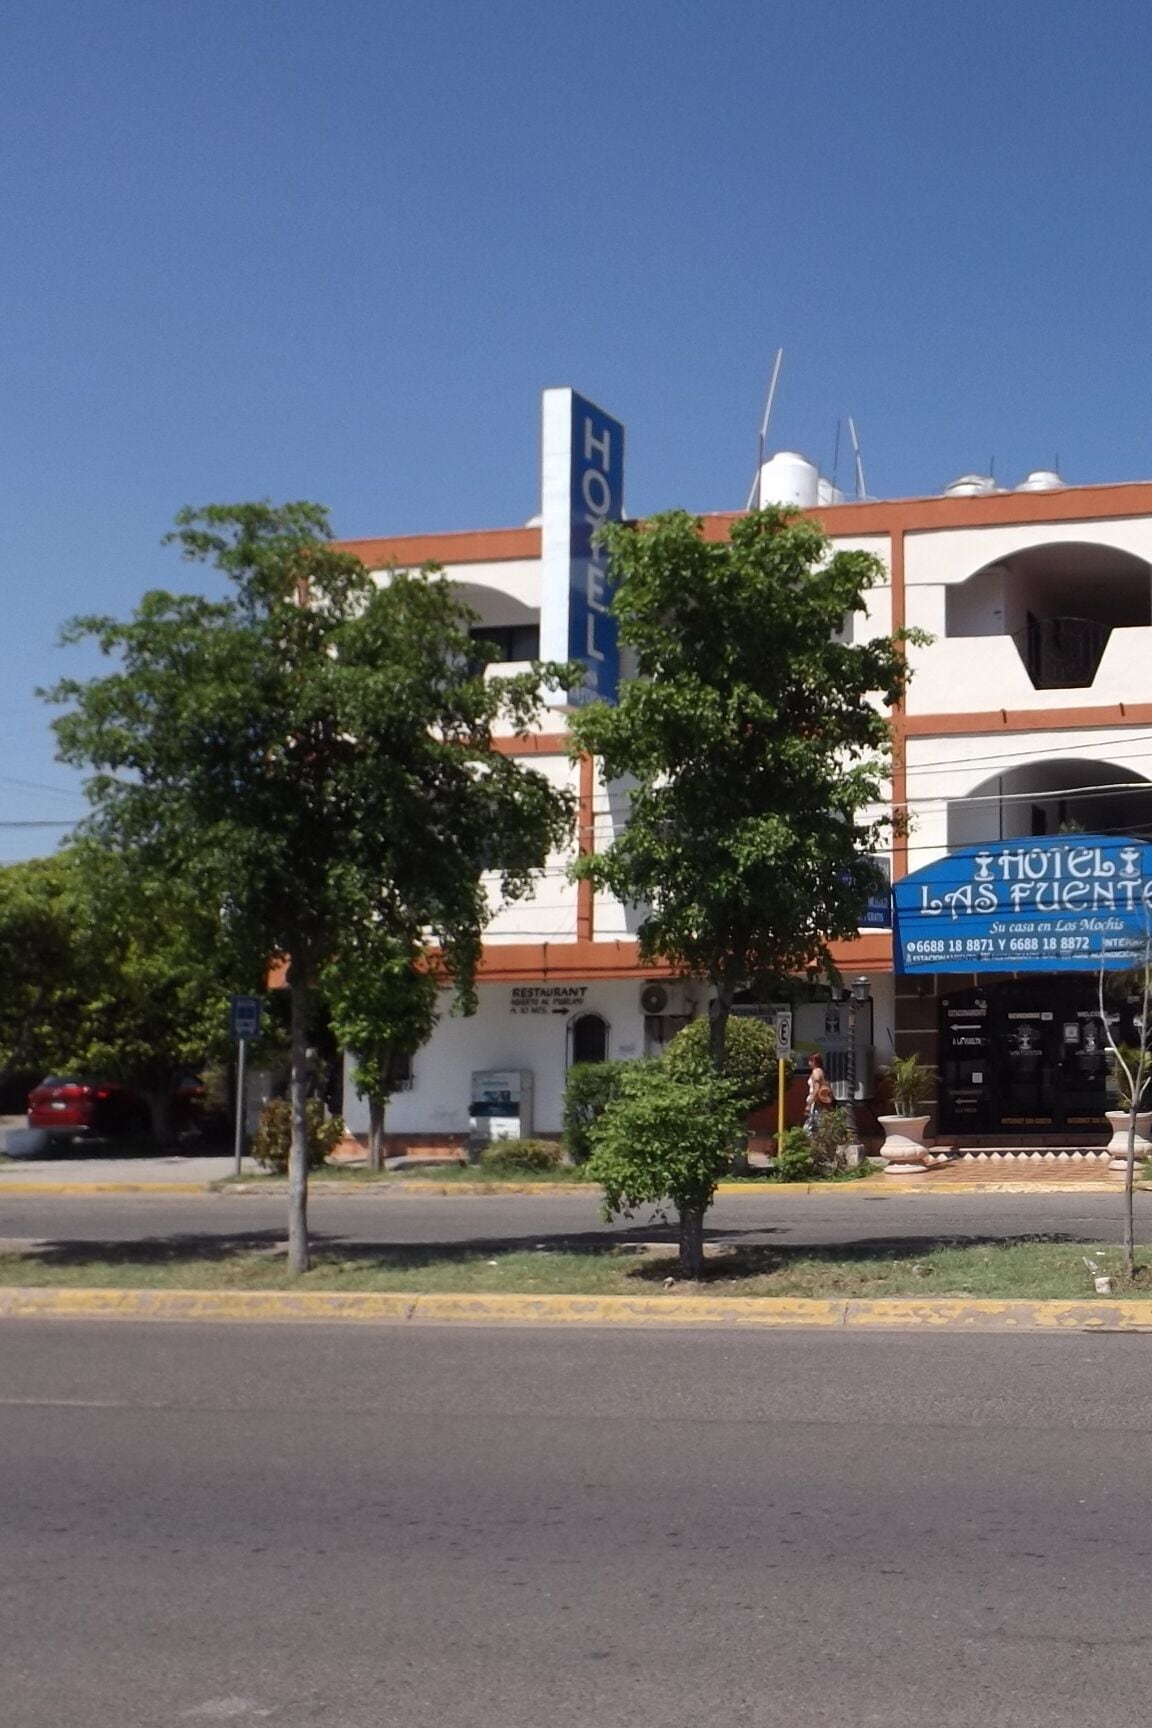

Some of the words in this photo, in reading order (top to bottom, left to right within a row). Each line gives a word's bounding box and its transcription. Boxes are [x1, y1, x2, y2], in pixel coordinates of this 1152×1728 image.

[998, 848, 1115, 880] HOTEL
[920, 882, 999, 920] LAS
[989, 921, 1006, 934] Su
[1009, 923, 1034, 933] casa
[1037, 922, 1051, 932] en
[1055, 919, 1077, 931] Los
[1079, 917, 1125, 931] Mochis
[916, 940, 945, 952] 6688
[949, 940, 963, 951] 18
[966, 939, 994, 951] 8871
[998, 939, 1006, 950] Y
[1010, 938, 1038, 950] 6688
[1042, 938, 1057, 950] 18
[1060, 937, 1090, 949] 8872
[512, 986, 588, 998] RESTAURANT
